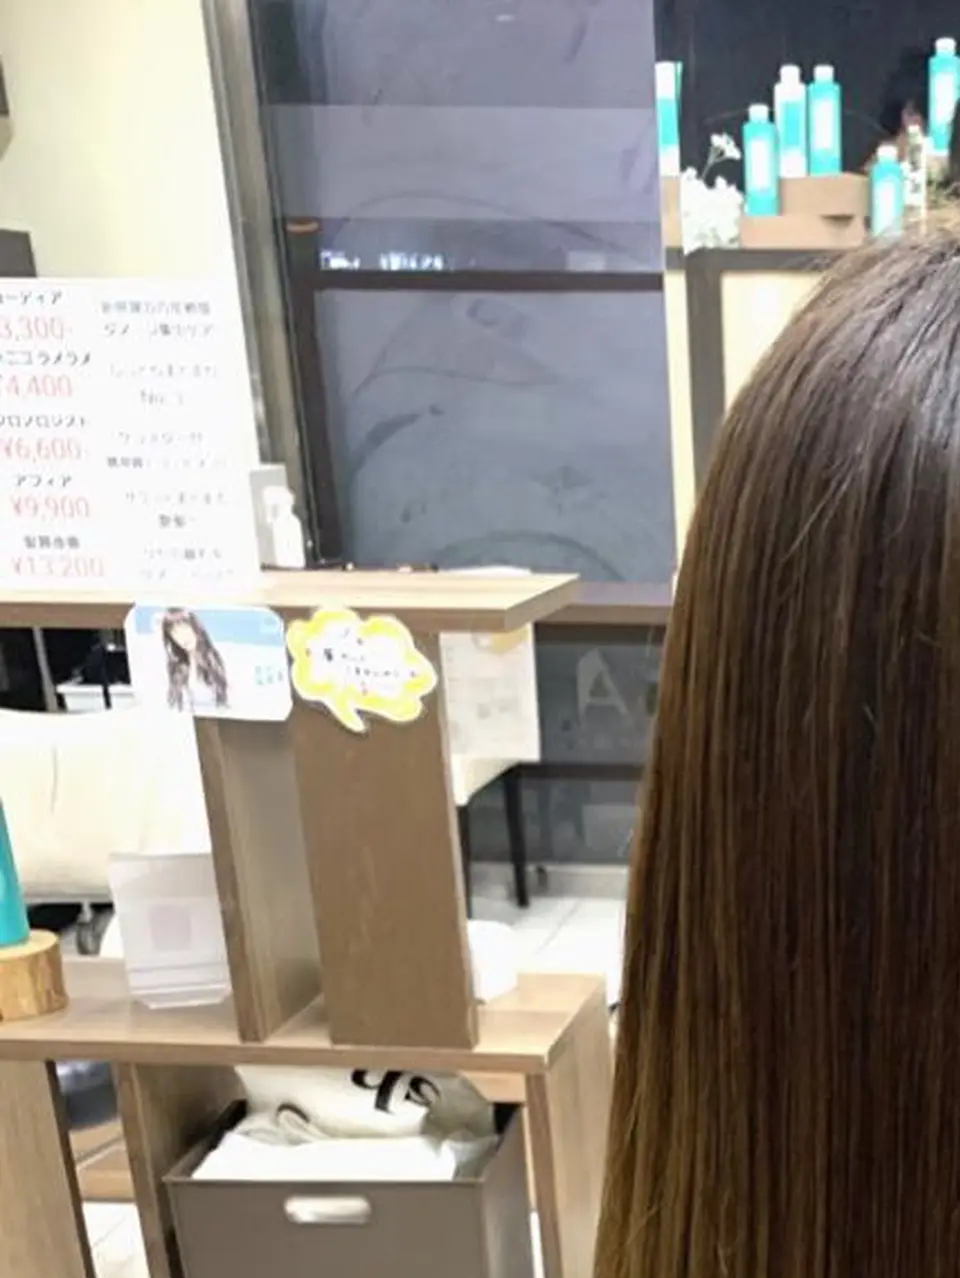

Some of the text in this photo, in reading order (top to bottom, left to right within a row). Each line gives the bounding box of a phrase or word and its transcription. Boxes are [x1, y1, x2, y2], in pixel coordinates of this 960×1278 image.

[0, 350, 91, 367] ニコラメラメ
[0, 373, 73, 399] 4,400
